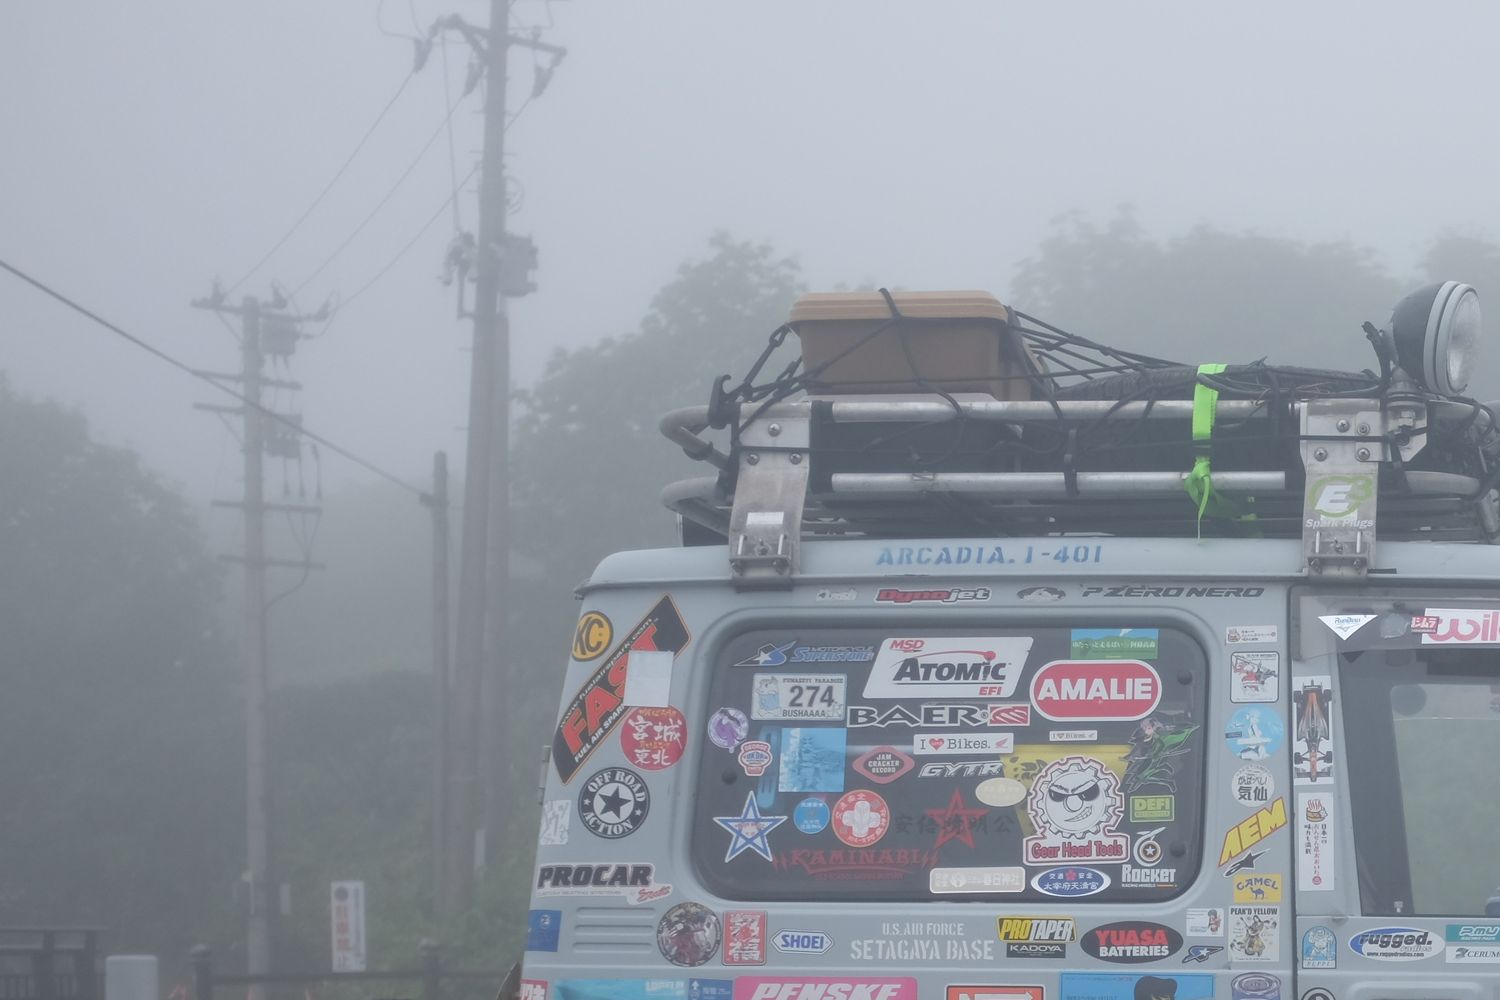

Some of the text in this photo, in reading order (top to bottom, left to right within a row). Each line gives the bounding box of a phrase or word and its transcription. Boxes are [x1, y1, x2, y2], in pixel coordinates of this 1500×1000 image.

[1305, 518, 1374, 528] Spark Plugs
[875, 589, 992, 602] Dynojet
[1185, 587, 1265, 598] NERO
[890, 639, 925, 650] MSD
[789, 686, 835, 708] 274
[978, 686, 1002, 696] EFI
[1038, 677, 1153, 701] AMALIE
[847, 706, 982, 727] BAER
[920, 737, 991, 750] I Bikes.
[586, 769, 647, 804] OFF ROAD
[1238, 787, 1268, 801] 気仙
[583, 812, 636, 838] ACTION
[1218, 797, 1287, 866] AEM
[1032, 840, 1123, 858] Gear Head Tools
[537, 864, 653, 888] PROCAR
[1236, 877, 1279, 891] CAMEL
[781, 934, 824, 950] SHOEI
[1095, 930, 1167, 946] YUASA
[850, 940, 994, 961] SETAGAYA BASE
[1009, 944, 1062, 953] KADOYA
[1099, 945, 1169, 957] BATTERIES
